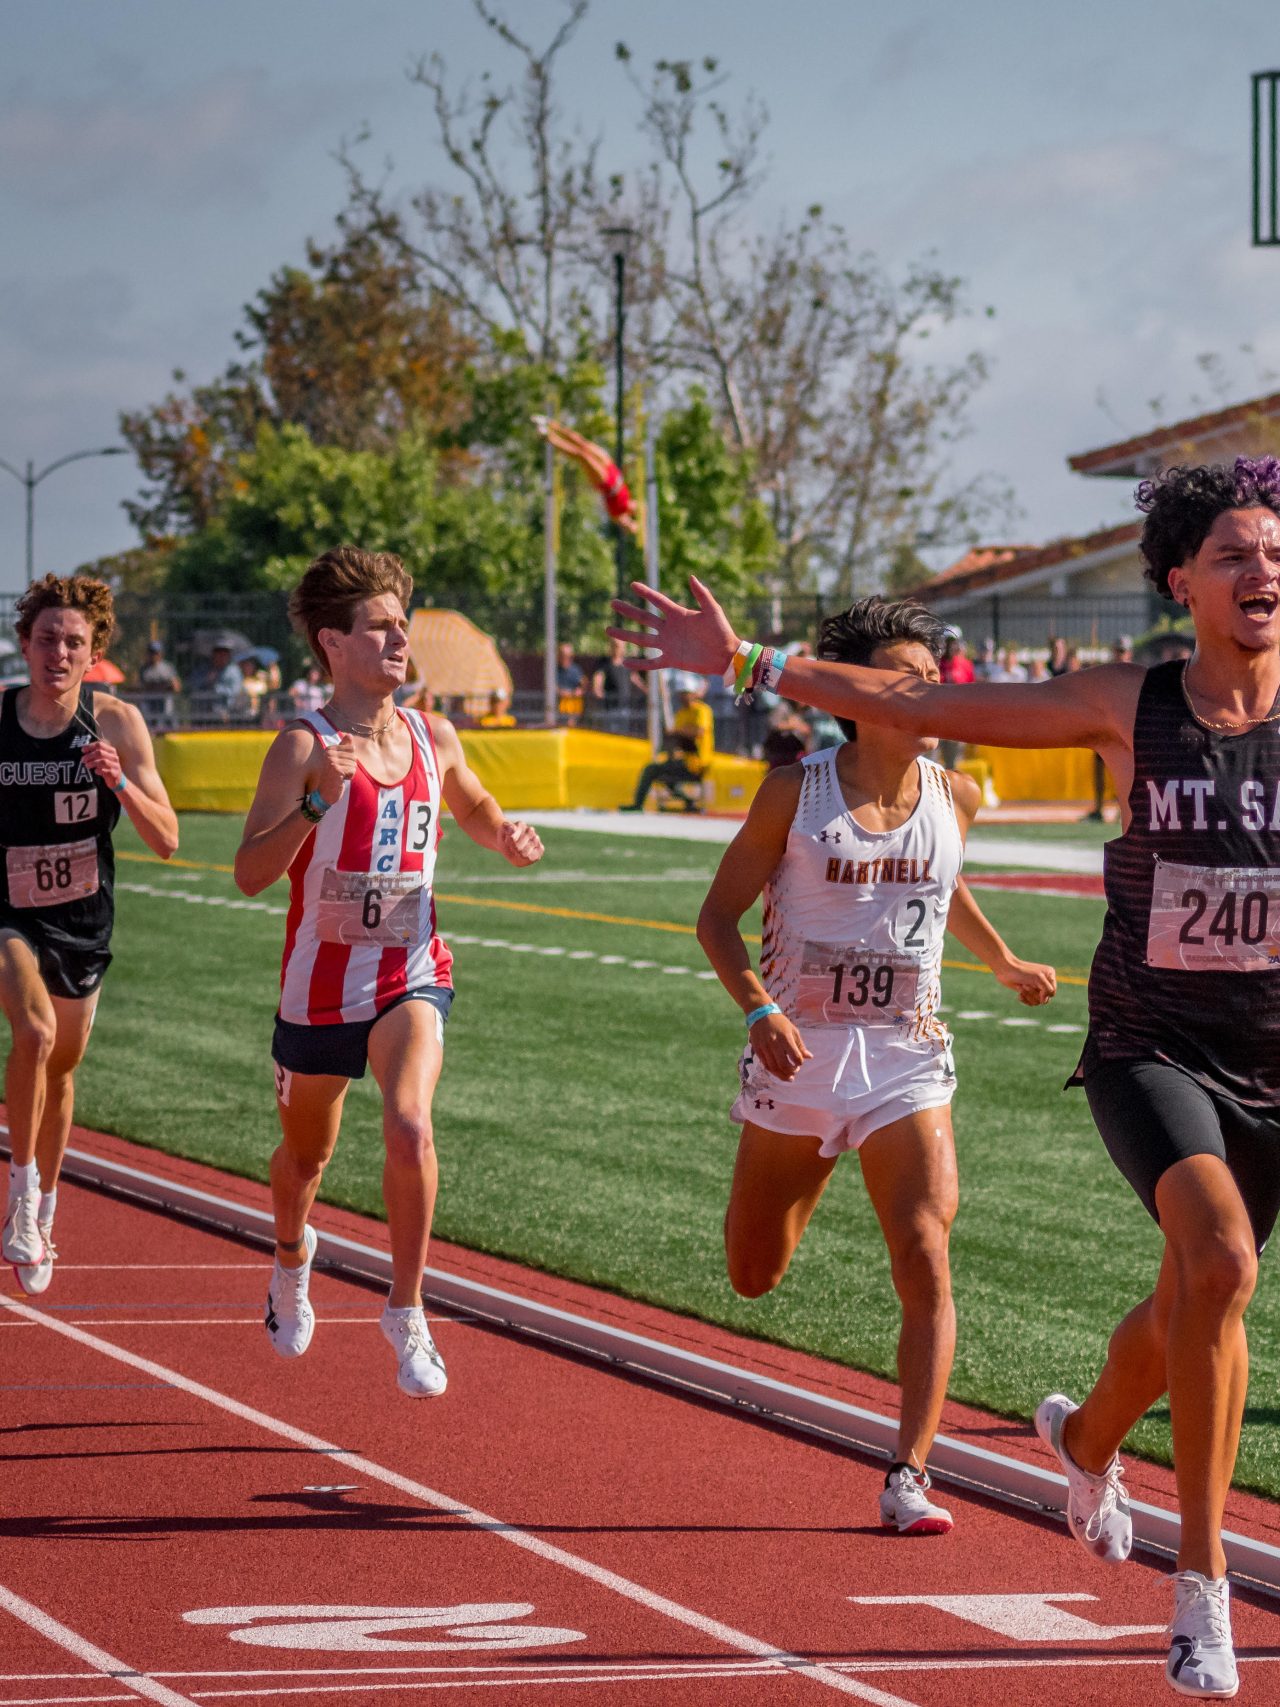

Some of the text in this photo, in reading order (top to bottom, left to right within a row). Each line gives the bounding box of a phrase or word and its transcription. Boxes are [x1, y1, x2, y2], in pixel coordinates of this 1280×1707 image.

[0, 760, 94, 786] CUESTA
[62, 793, 91, 822] 12
[413, 804, 432, 851] 3
[1146, 779, 1227, 832] MT.
[35, 857, 72, 892] 68
[824, 857, 934, 885] HARTNELL
[361, 888, 383, 930] 6
[904, 899, 927, 948] 2
[1178, 888, 1270, 947] 240
[829, 962, 895, 1008] 139
[181, 1602, 588, 1652] 2
